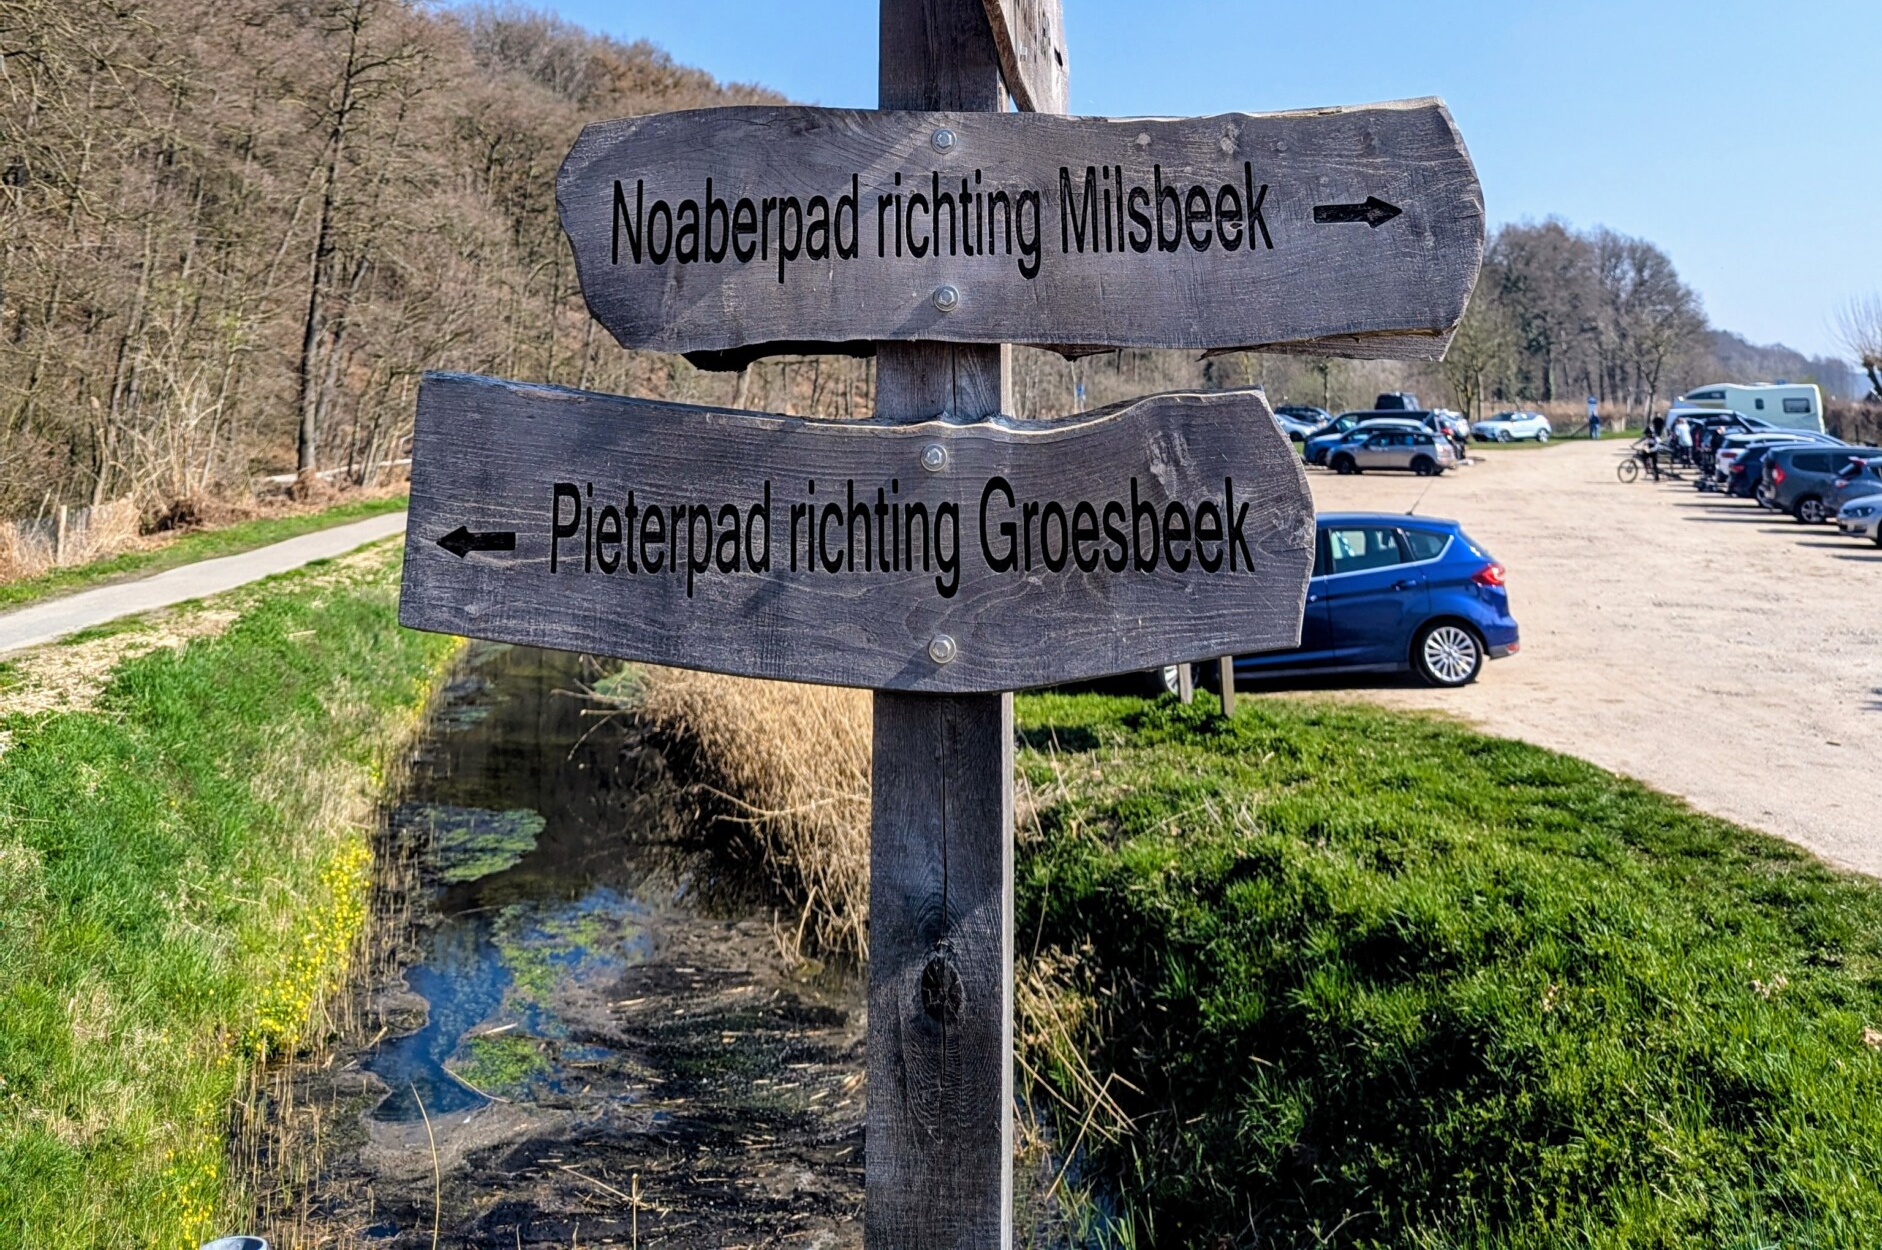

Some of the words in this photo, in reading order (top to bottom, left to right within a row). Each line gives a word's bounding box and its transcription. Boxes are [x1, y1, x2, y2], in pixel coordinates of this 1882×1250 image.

[611, 173, 858, 284] Noaberpad
[877, 168, 1042, 280] richting
[1060, 161, 1274, 254] Milsbeek
[551, 479, 770, 599] Pieterpad
[790, 478, 961, 599] richting
[979, 476, 1256, 574] Groesbeek
